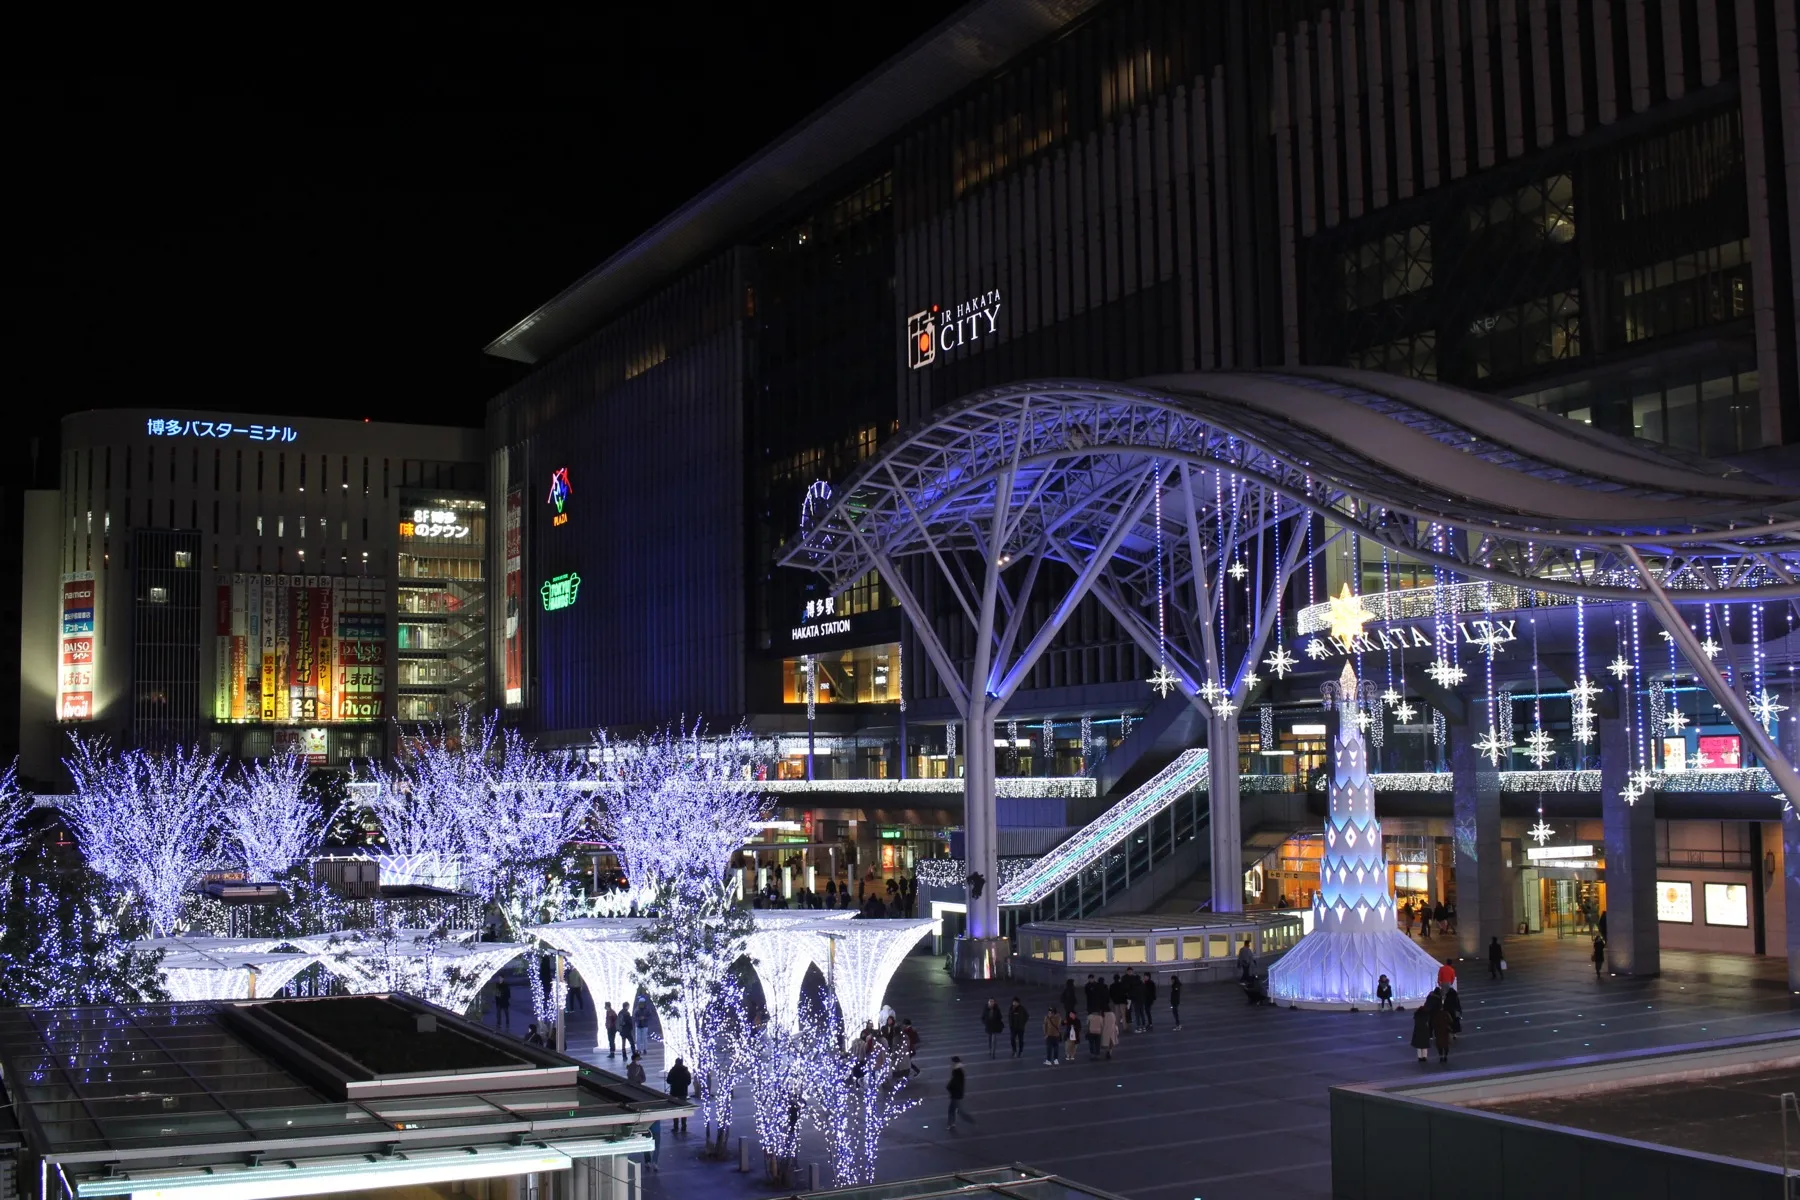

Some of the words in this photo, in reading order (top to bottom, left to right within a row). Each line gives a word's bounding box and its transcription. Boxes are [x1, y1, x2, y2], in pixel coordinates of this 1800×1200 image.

[940, 309, 952, 326] JR
[957, 288, 1001, 318] HAKATA
[940, 303, 1001, 351] CITY
[147, 418, 298, 442] 博多バスターミナル
[413, 509, 430, 523] 8F
[64, 590, 92, 600] namco
[320, 588, 332, 636] ゴーゴーカレー
[806, 597, 835, 618] 博多駅
[65, 624, 88, 635] デコホーム
[792, 625, 820, 640] HAKATA
[821, 619, 851, 635] STATION
[1327, 626, 1432, 655] HAKATA
[1437, 619, 1517, 644] CITY
[64, 641, 90, 653] DAISO
[342, 645, 382, 656] DAISO
[64, 671, 91, 686] しまむら
[340, 671, 383, 686] しまむら
[63, 701, 89, 718] Avail
[340, 700, 382, 718] Avail
